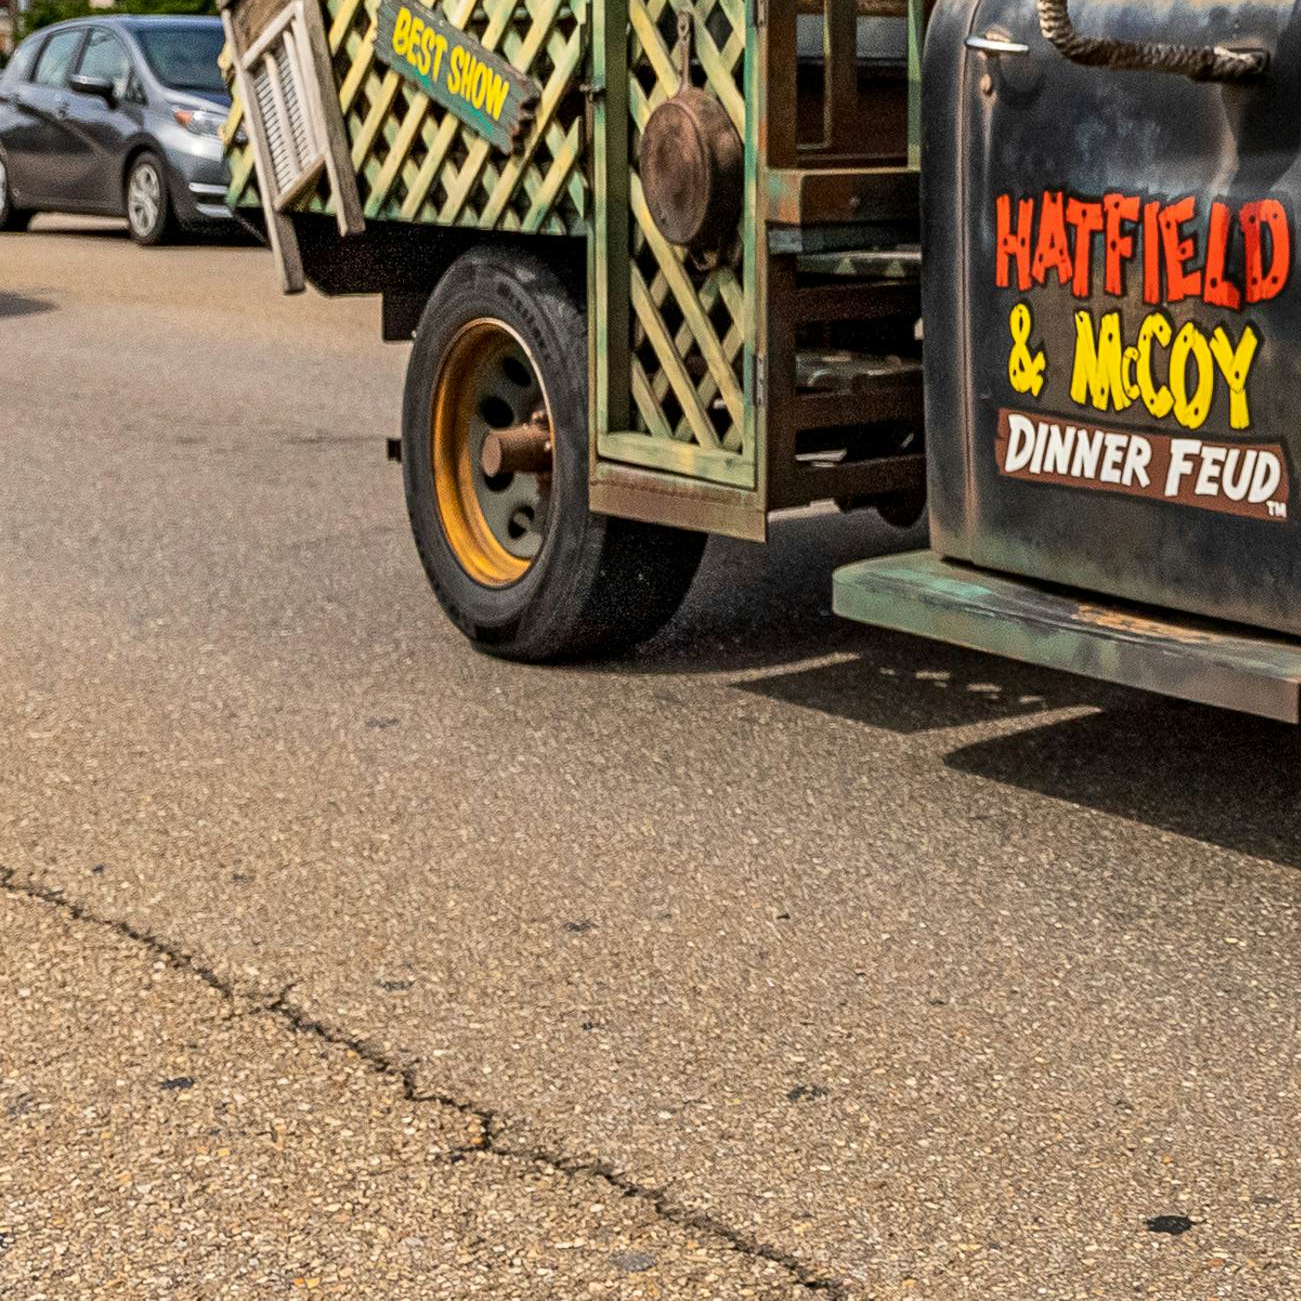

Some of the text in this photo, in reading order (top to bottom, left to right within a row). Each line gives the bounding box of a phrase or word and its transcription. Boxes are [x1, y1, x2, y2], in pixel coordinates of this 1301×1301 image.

[392, 6, 511, 121] BEST SHOW
[996, 190, 1291, 311] HATFIELD
[1008, 303, 1046, 397] &
[1005, 413, 1151, 488] DINNER
[1164, 438, 1281, 504] FEUD
